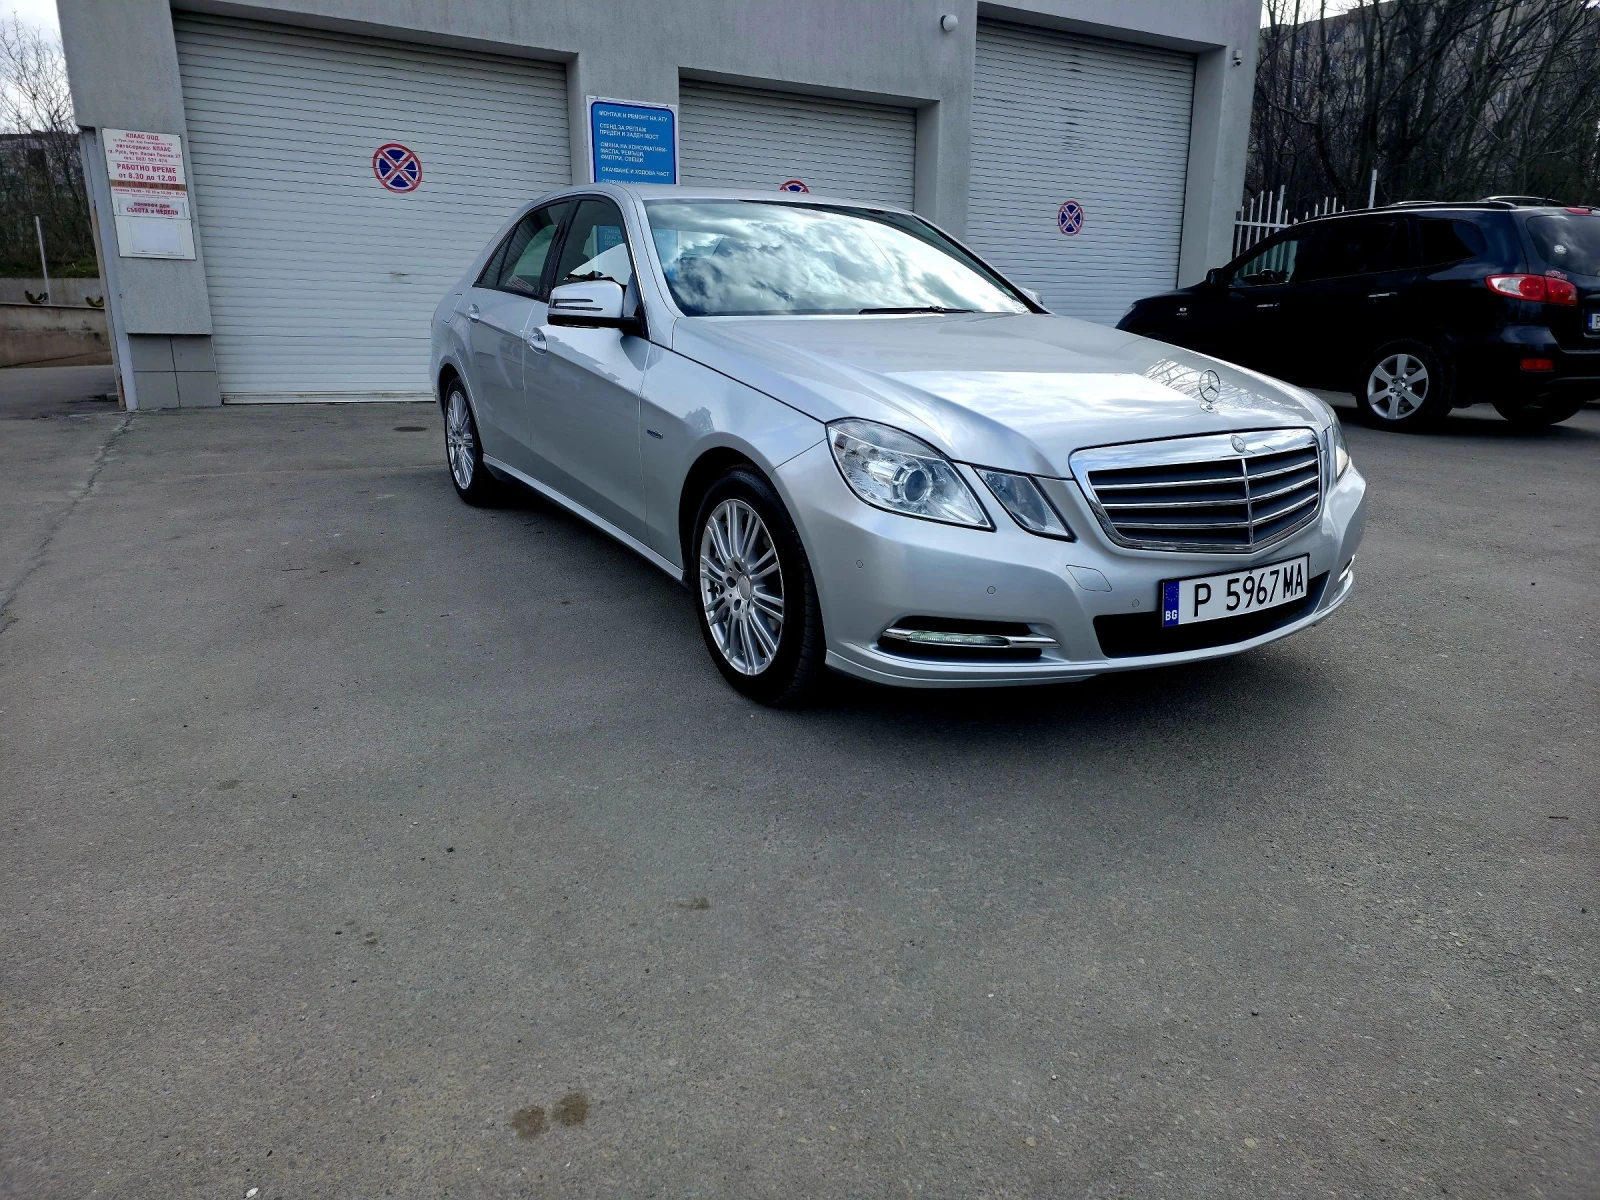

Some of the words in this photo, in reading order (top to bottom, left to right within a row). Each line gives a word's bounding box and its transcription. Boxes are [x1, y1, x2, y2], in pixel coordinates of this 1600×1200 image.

[117, 163, 149, 171] РАБОТНО
[1166, 610, 1177, 621] BG
[1194, 583, 1211, 617] P
